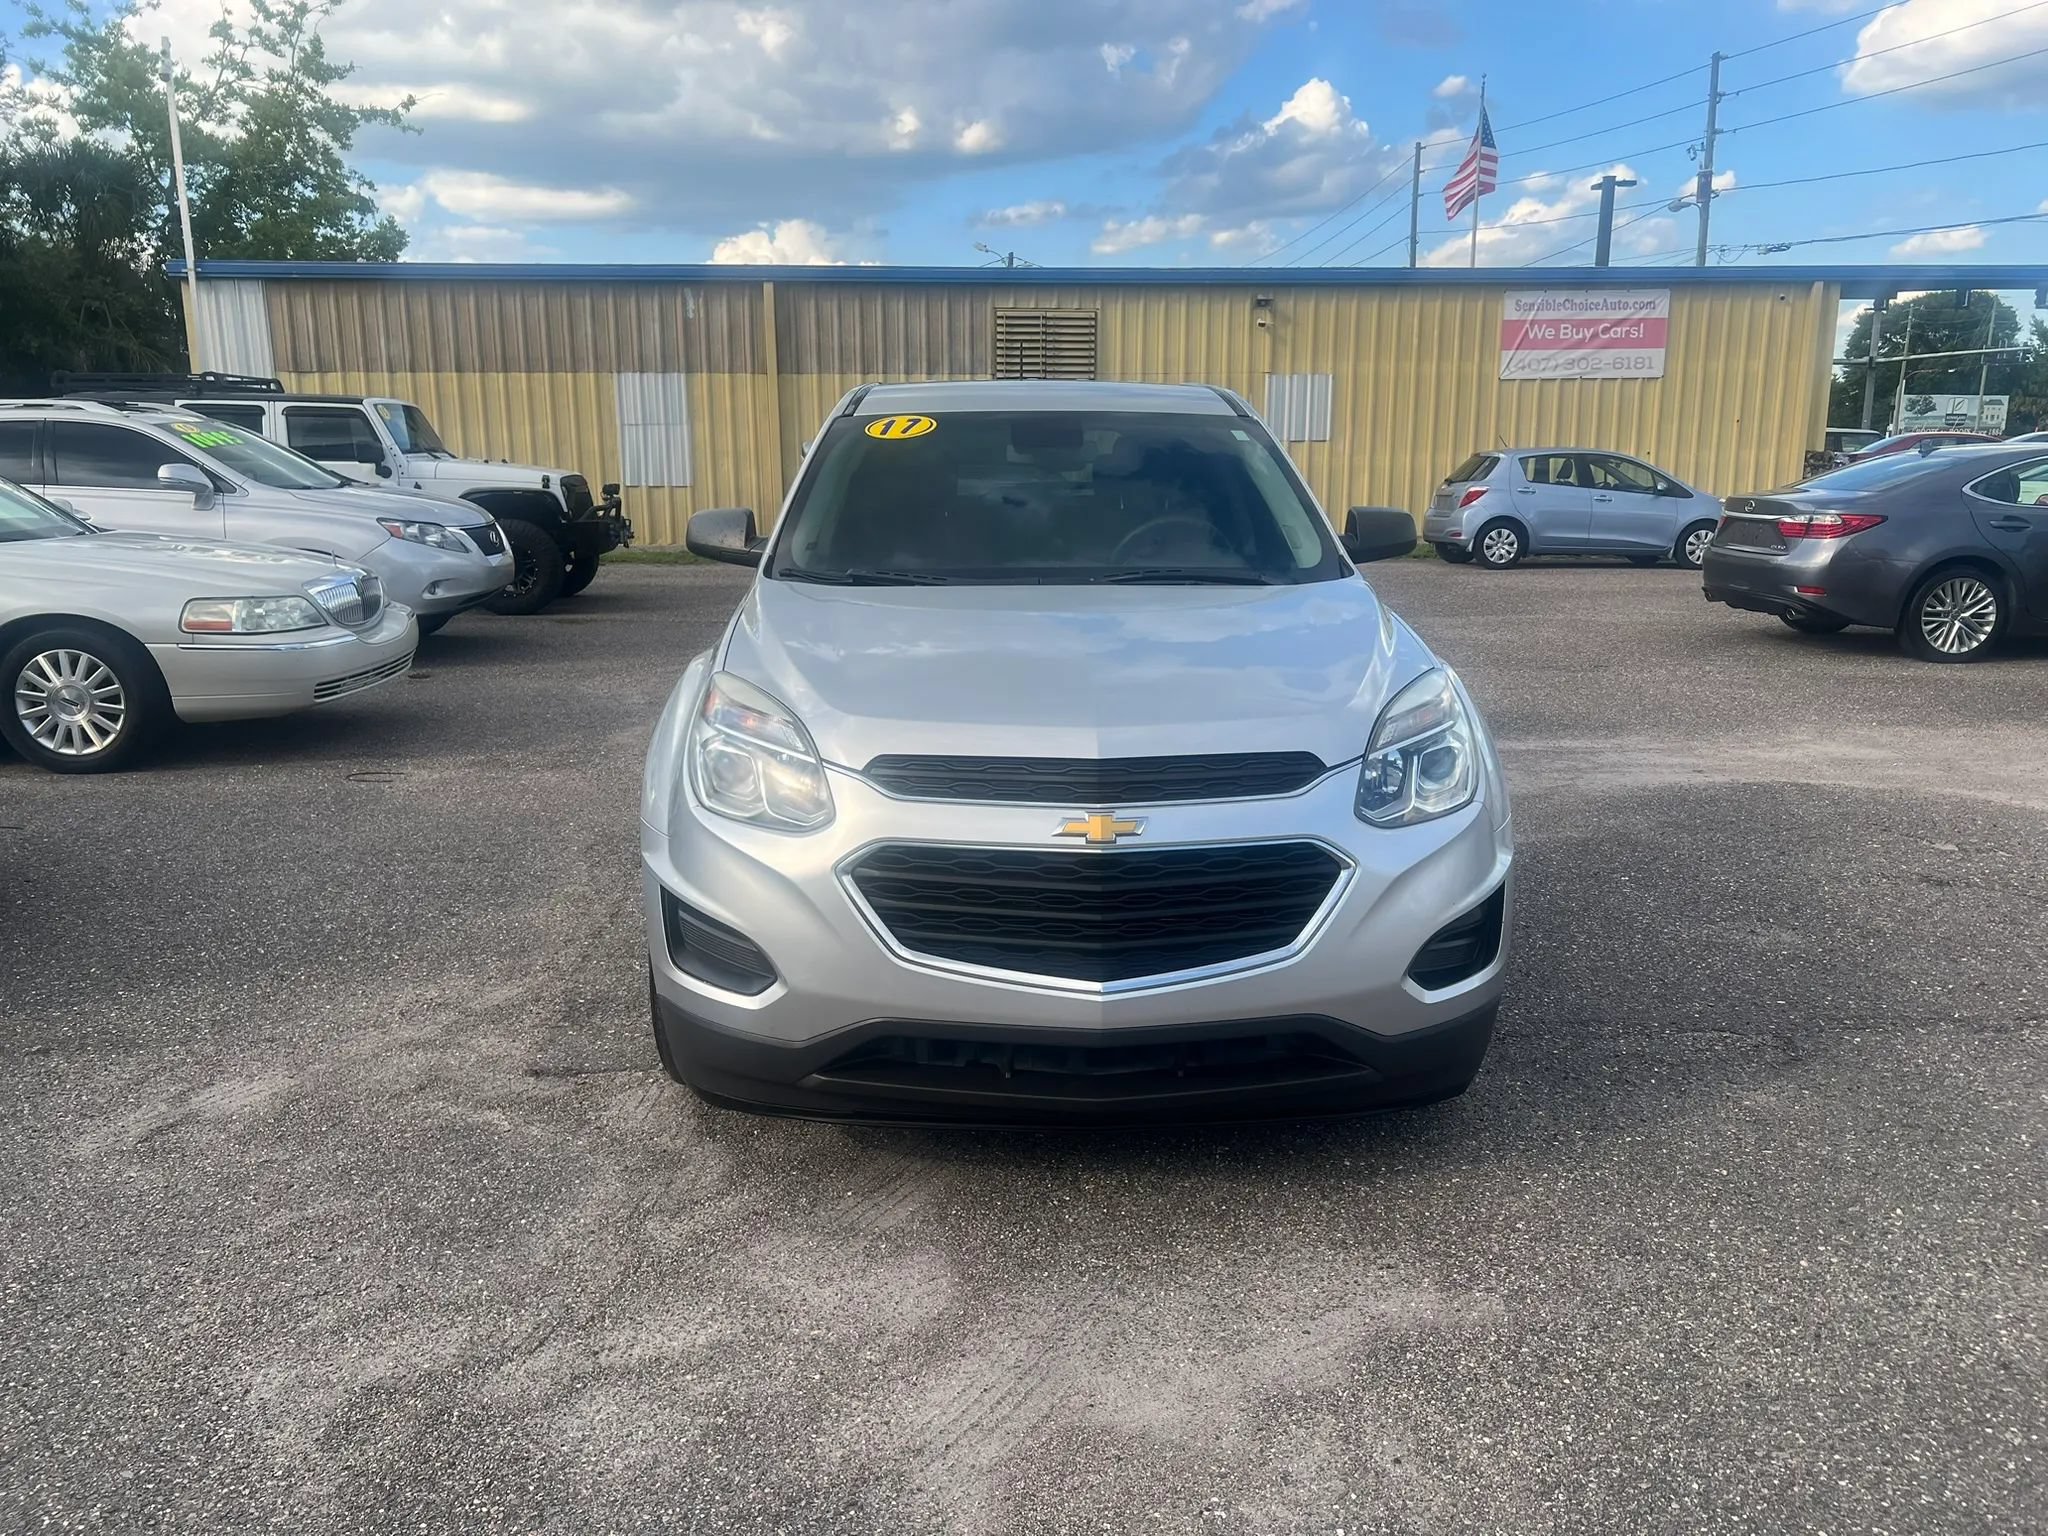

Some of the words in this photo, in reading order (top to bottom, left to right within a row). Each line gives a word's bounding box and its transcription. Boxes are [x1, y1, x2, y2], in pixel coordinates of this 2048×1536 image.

[1527, 323, 1556, 339] We
[1560, 324, 1595, 343] Buy
[1599, 323, 1644, 339] Cars!
[1564, 356, 1654, 371] 302-6181
[879, 418, 922, 436] 17
